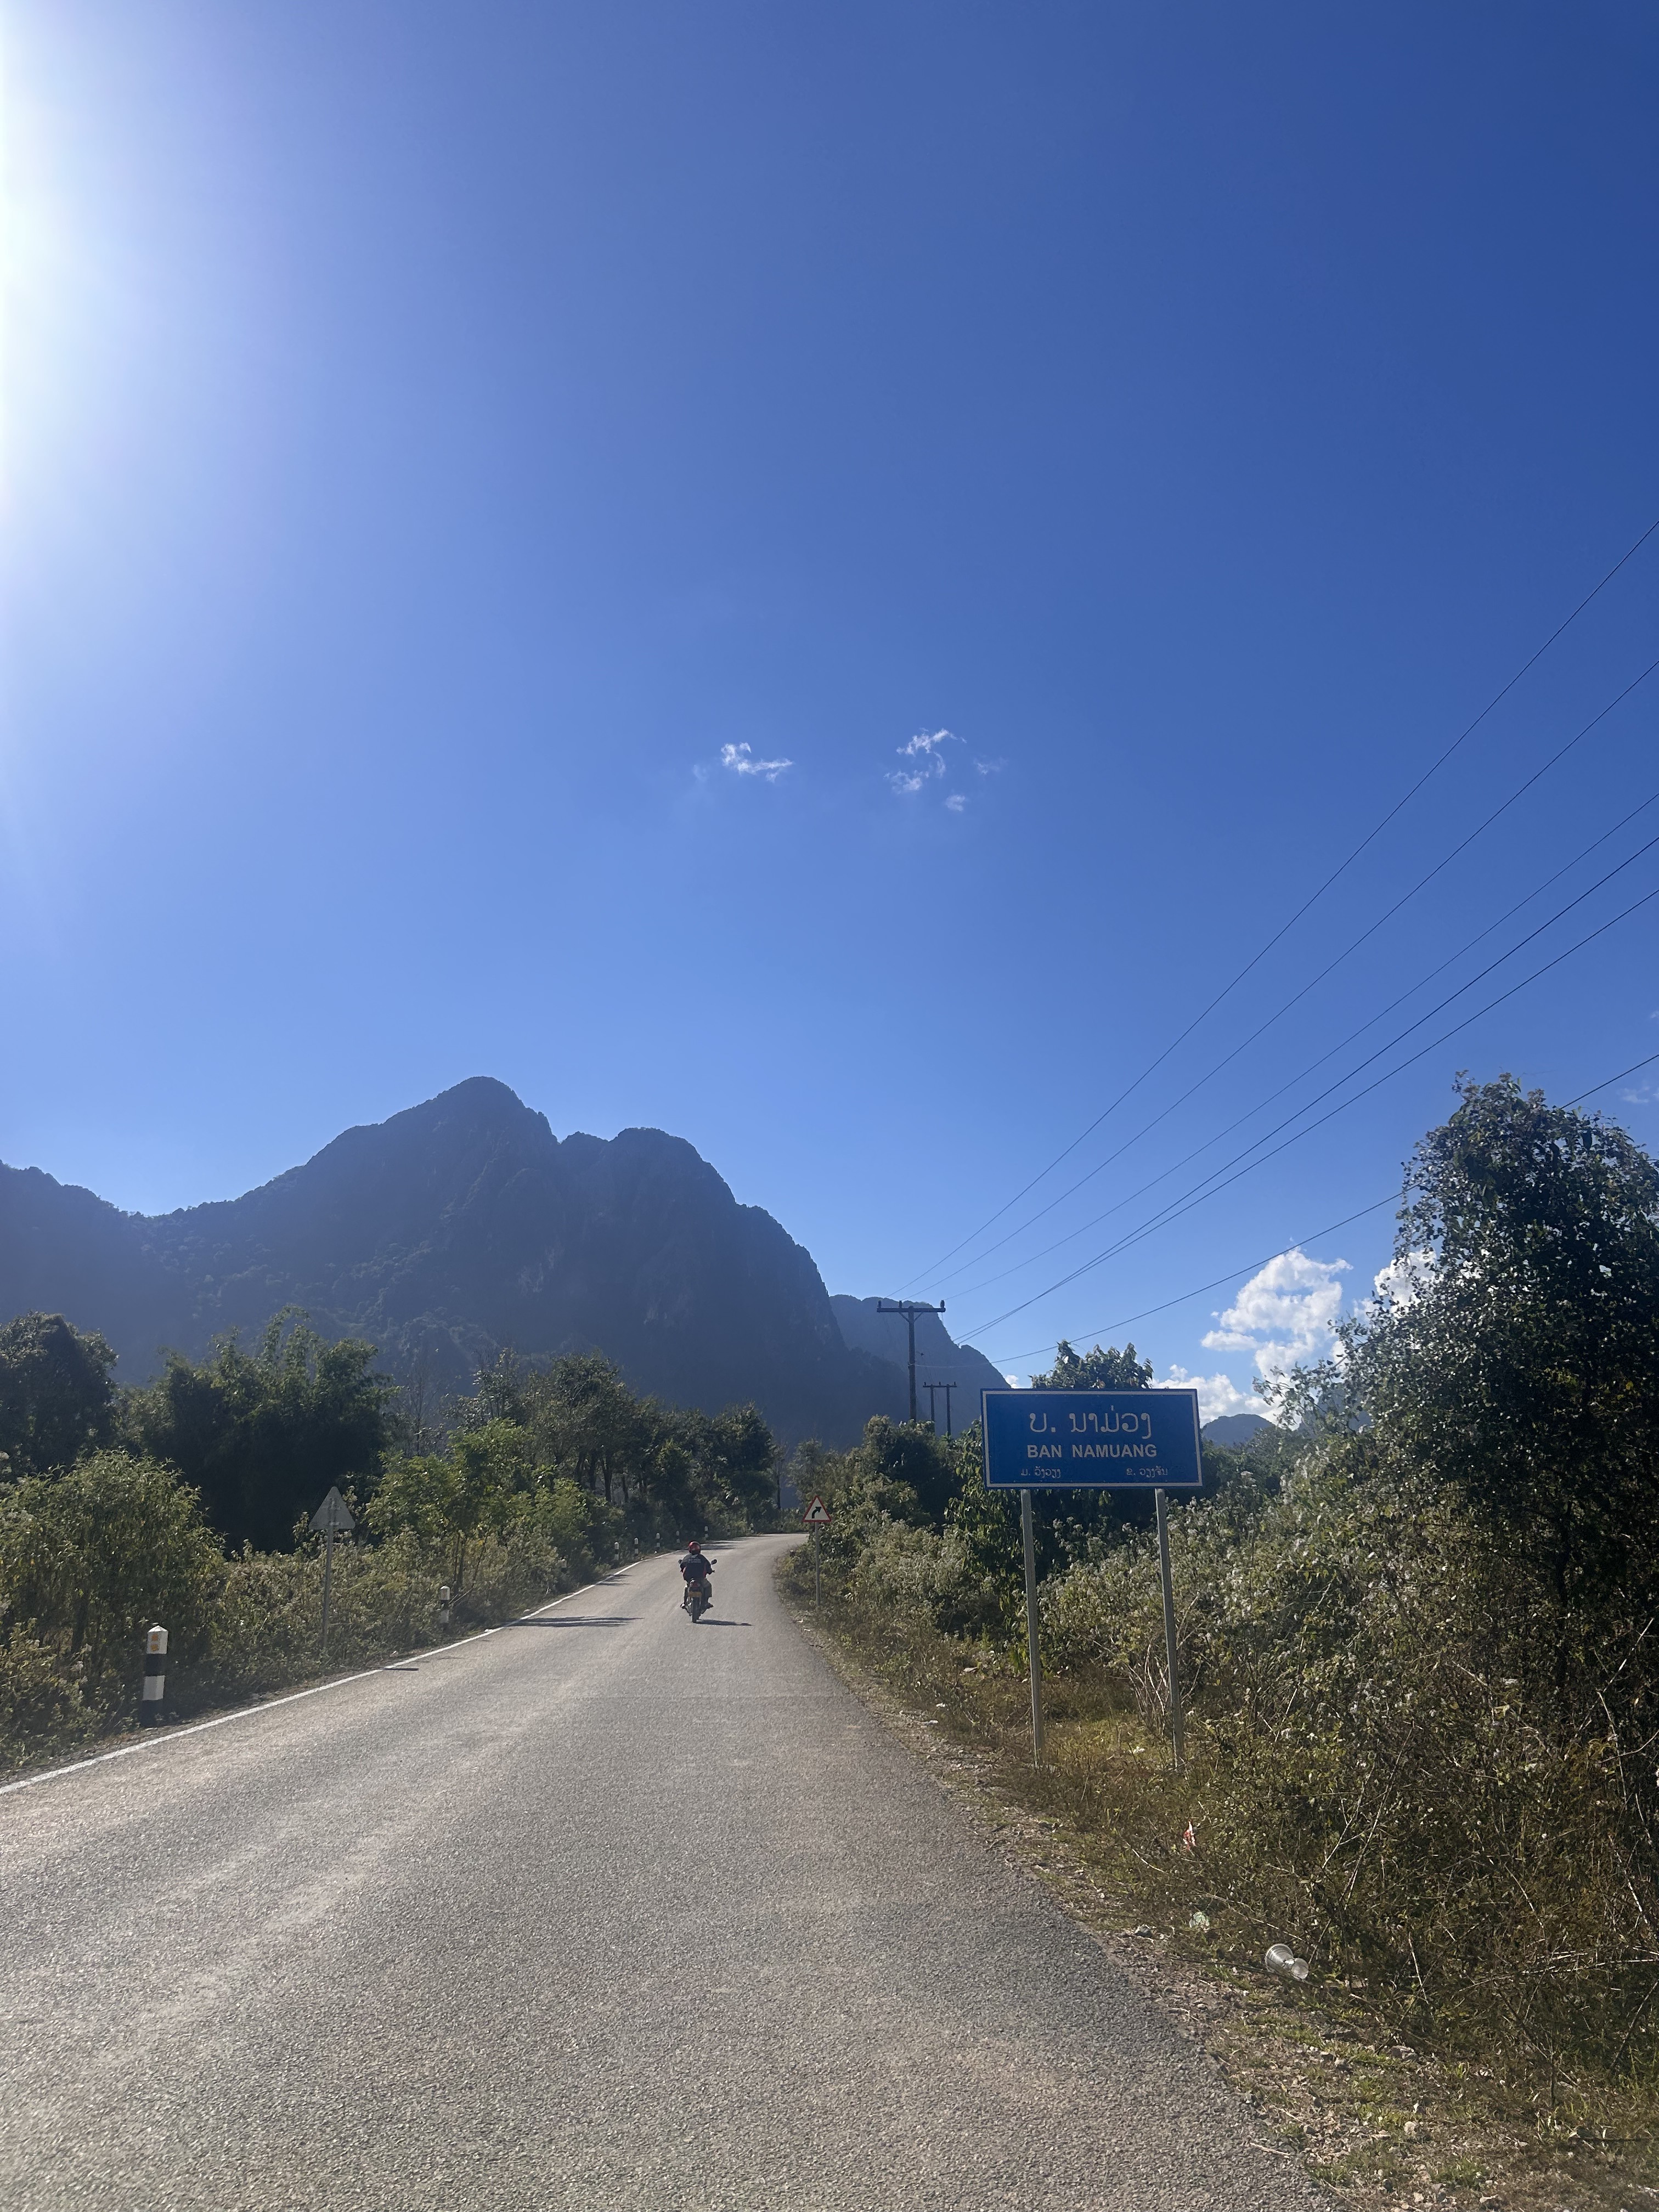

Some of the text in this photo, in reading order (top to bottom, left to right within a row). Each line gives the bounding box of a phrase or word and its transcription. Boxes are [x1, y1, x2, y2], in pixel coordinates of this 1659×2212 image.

[1069, 1405, 1152, 1440] ນາມ່ວງ
[1027, 1444, 1158, 1458] BAN NAMUANG
